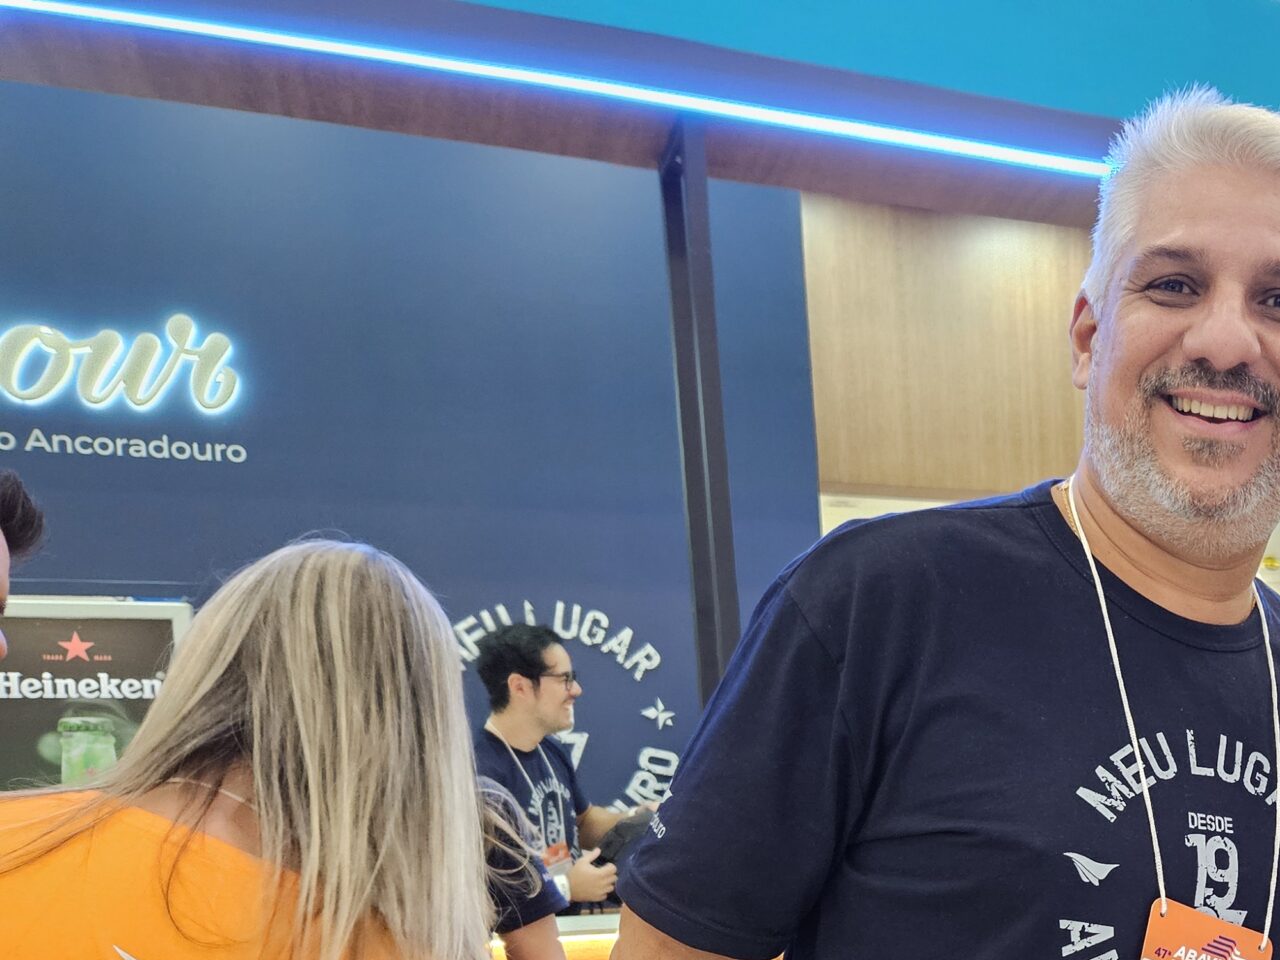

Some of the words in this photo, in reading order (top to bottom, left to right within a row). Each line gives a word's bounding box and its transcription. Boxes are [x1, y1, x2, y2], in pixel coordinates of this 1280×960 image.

[24, 428, 247, 463] Ancoradouro
[0, 671, 163, 700] Heineken
[1076, 731, 1178, 823] MEU
[1188, 812, 1233, 834] DESDE
[1184, 834, 1238, 912] 19
